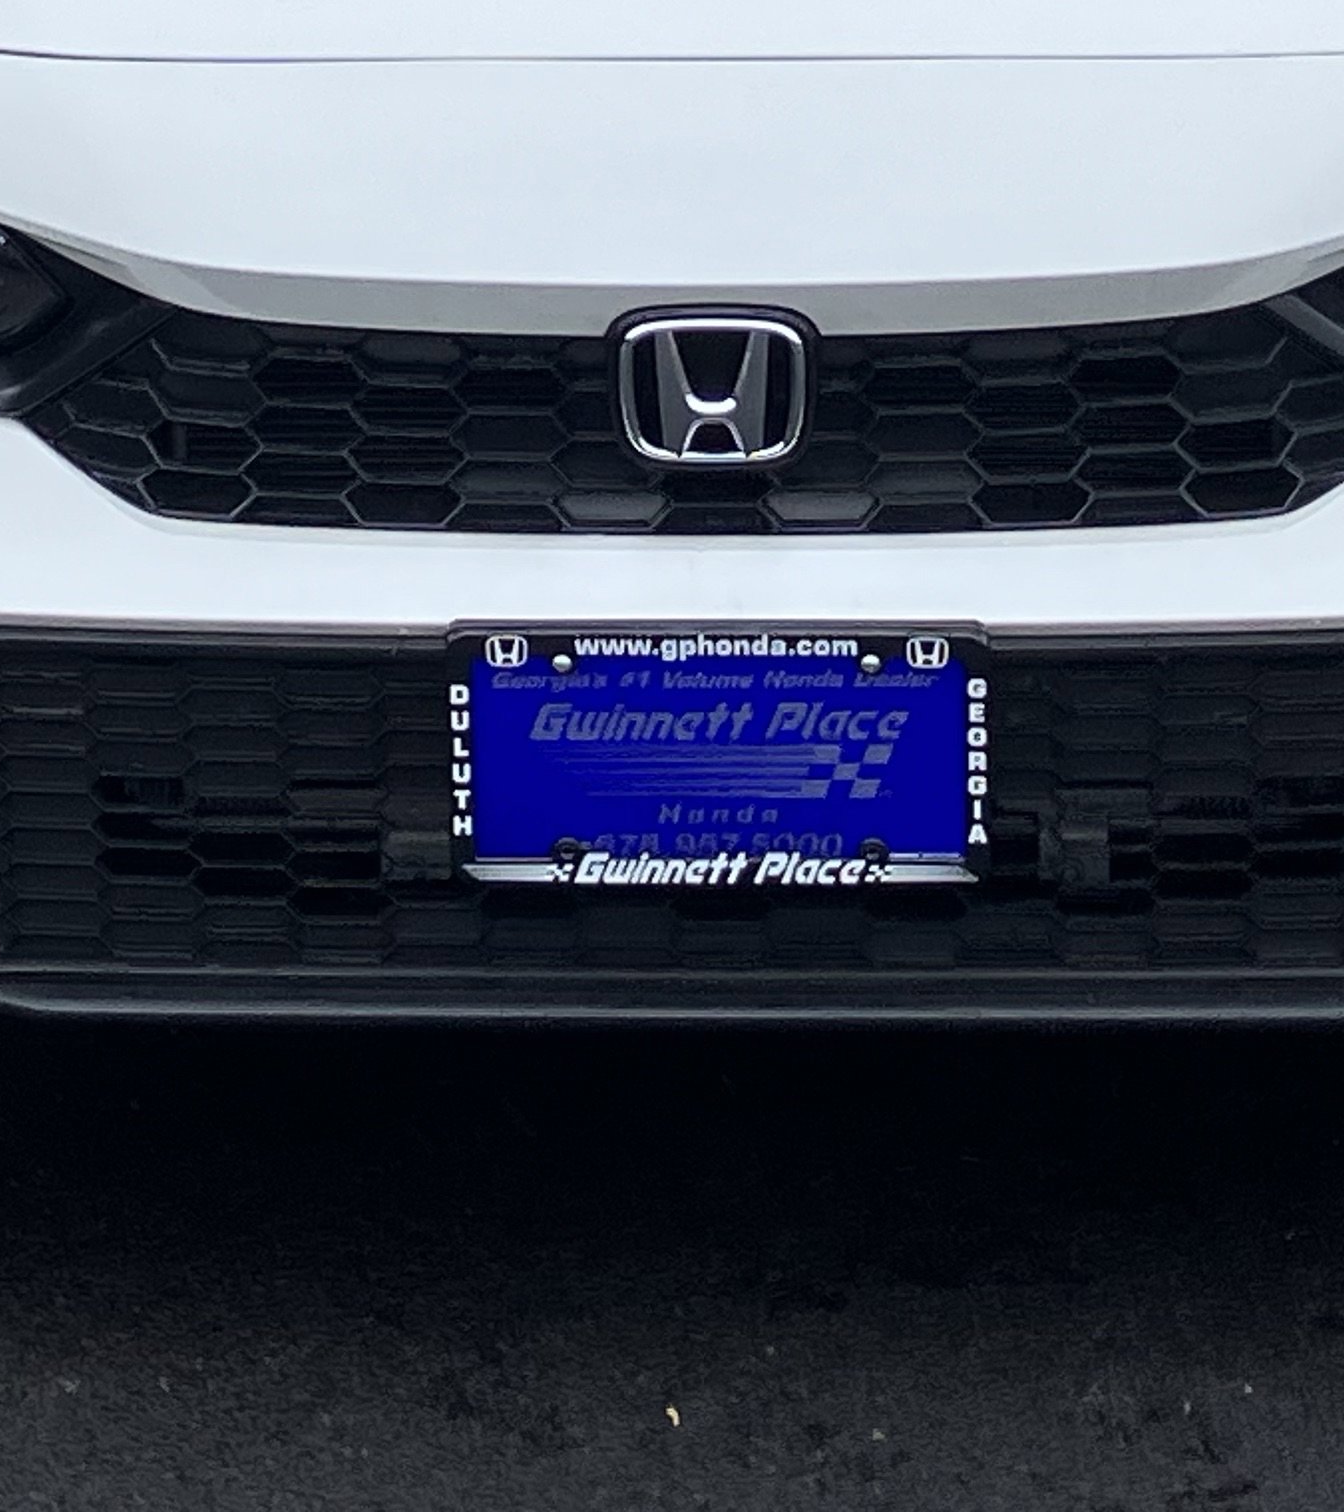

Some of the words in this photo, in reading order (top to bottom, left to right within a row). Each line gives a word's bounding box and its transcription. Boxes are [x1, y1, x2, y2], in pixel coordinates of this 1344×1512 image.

[573, 632, 858, 661] www.gphonda.com
[763, 668, 844, 689] Honda
[529, 701, 754, 742] Gwinnett
[765, 700, 910, 741] Place
[449, 684, 473, 837] DULUTH
[967, 677, 988, 844] GEORGIA
[658, 802, 780, 825] Honda
[574, 851, 749, 885] Gwinnett
[752, 851, 867, 885] Place
